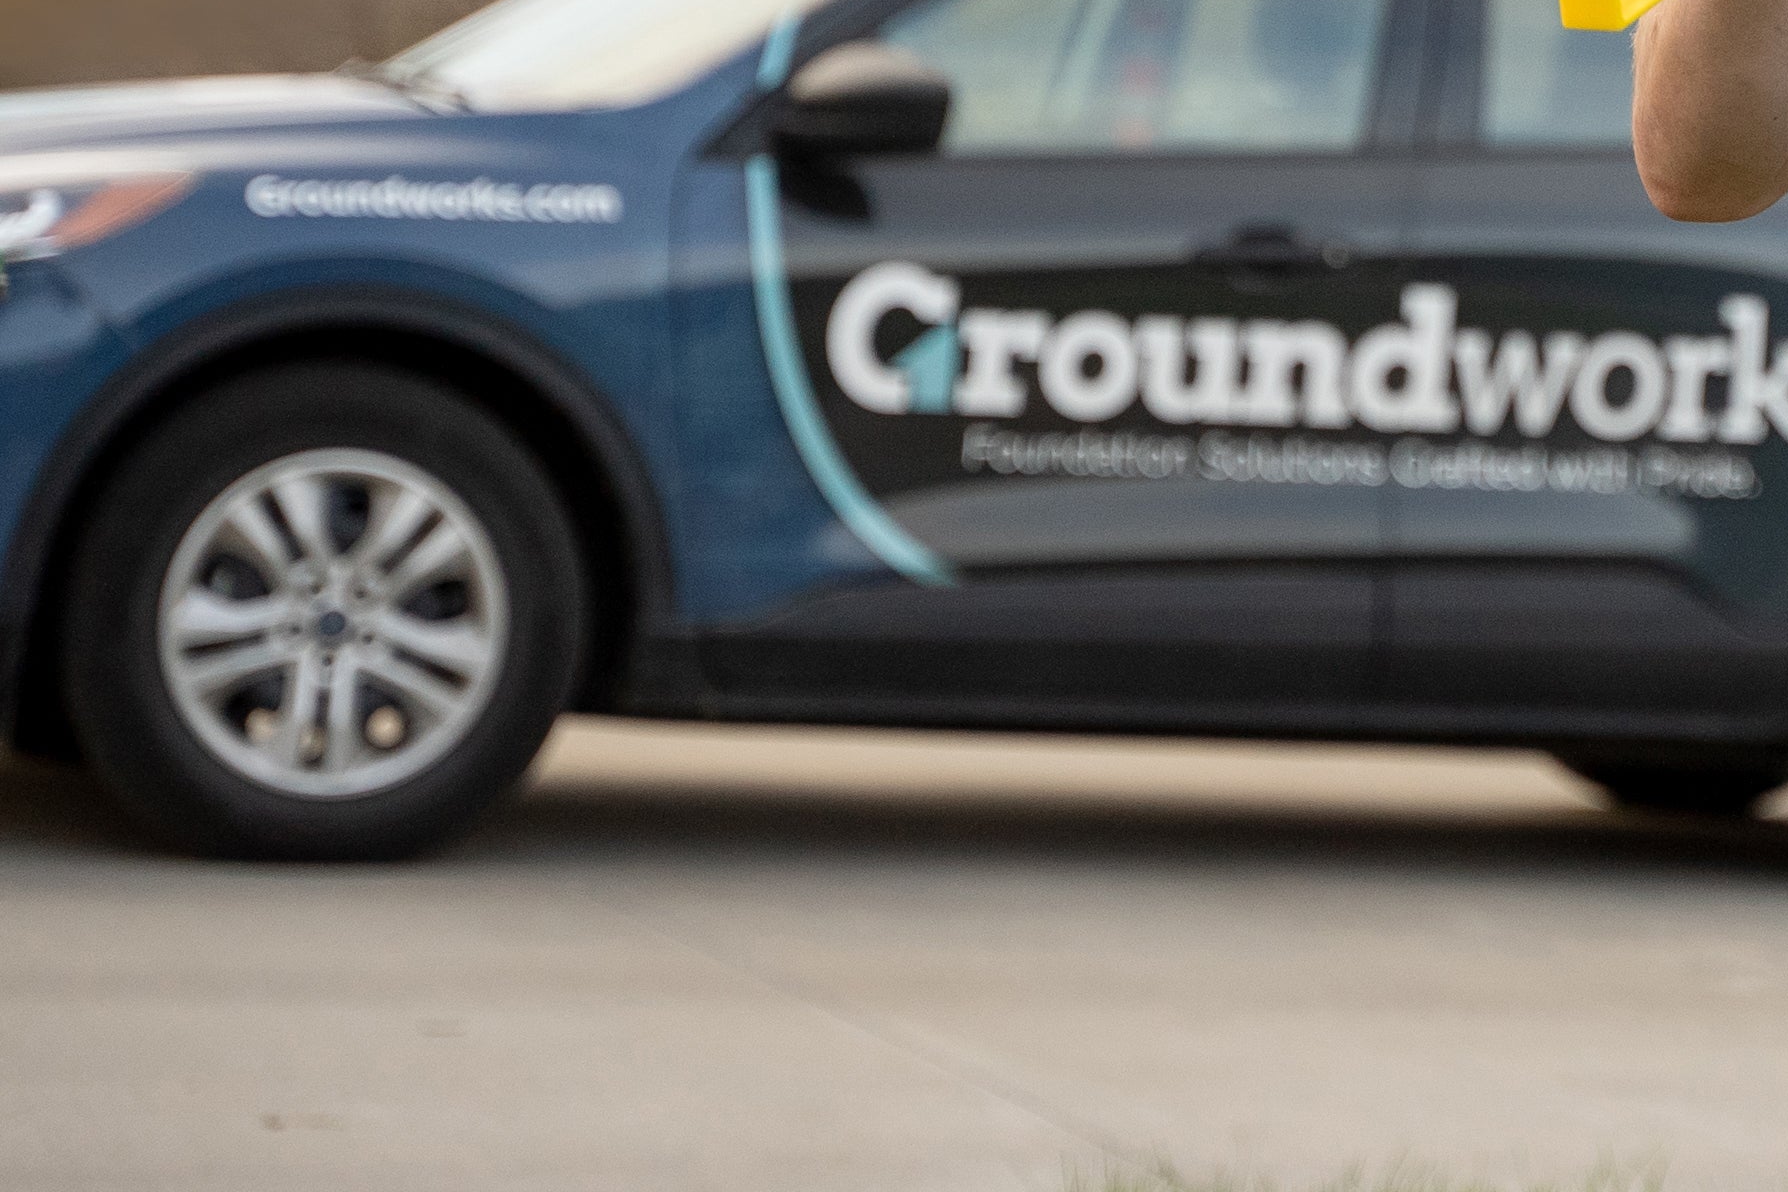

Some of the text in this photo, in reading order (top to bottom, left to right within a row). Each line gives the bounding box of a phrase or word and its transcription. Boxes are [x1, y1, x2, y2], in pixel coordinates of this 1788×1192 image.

[246, 174, 624, 224] Groundworks.com
[961, 420, 1193, 479] Foundation
[1198, 428, 1388, 488] Solutions
